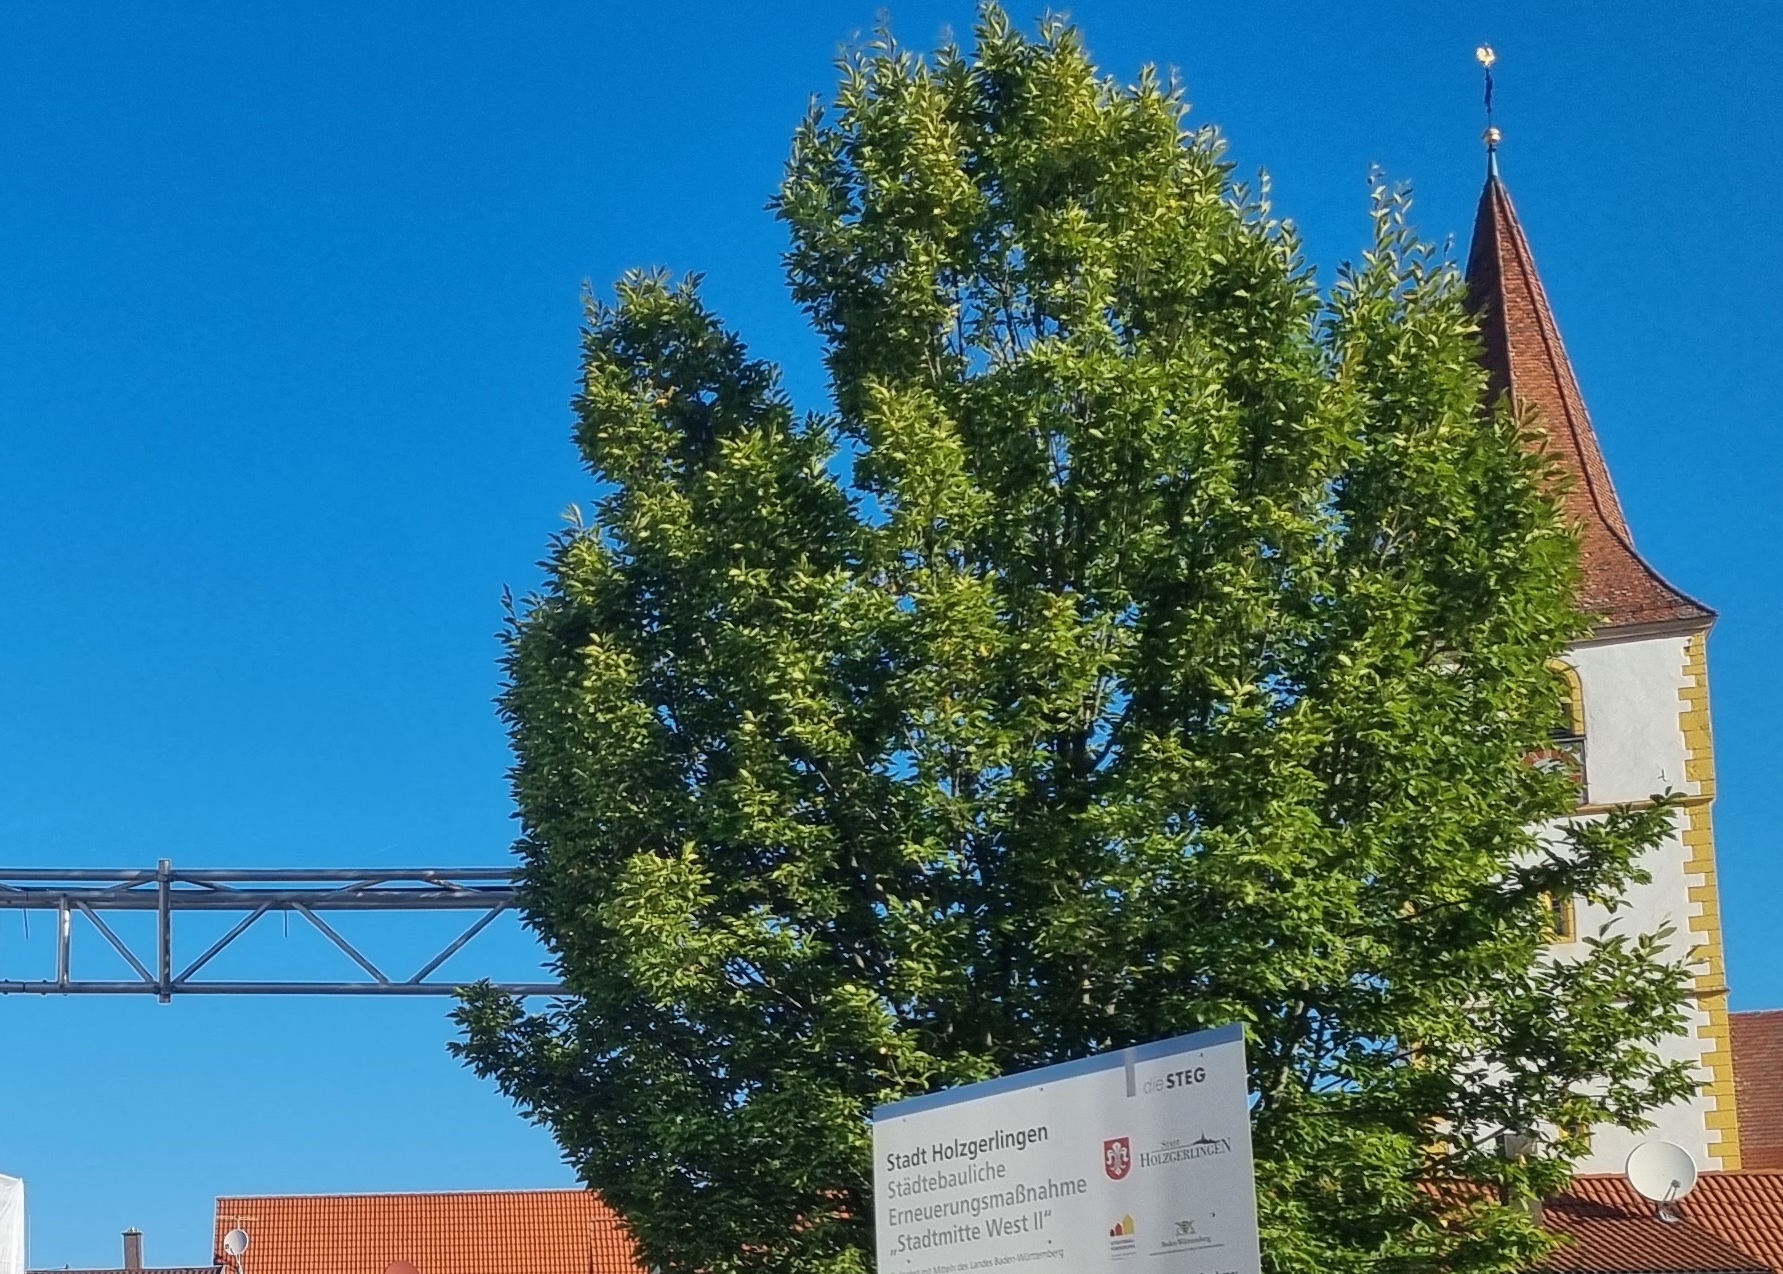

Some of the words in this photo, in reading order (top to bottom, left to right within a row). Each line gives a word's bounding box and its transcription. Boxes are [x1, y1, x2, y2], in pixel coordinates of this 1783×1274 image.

[1143, 1077, 1164, 1094] die
[1167, 1067, 1206, 1089] STEG
[887, 1147, 927, 1171] Stadt
[932, 1126, 1048, 1163] Holzgerlingen
[888, 1161, 1006, 1199] Städtebauliche
[889, 1178, 1087, 1226] Erneuerungsmaßnahme
[985, 1214, 1028, 1238] West
